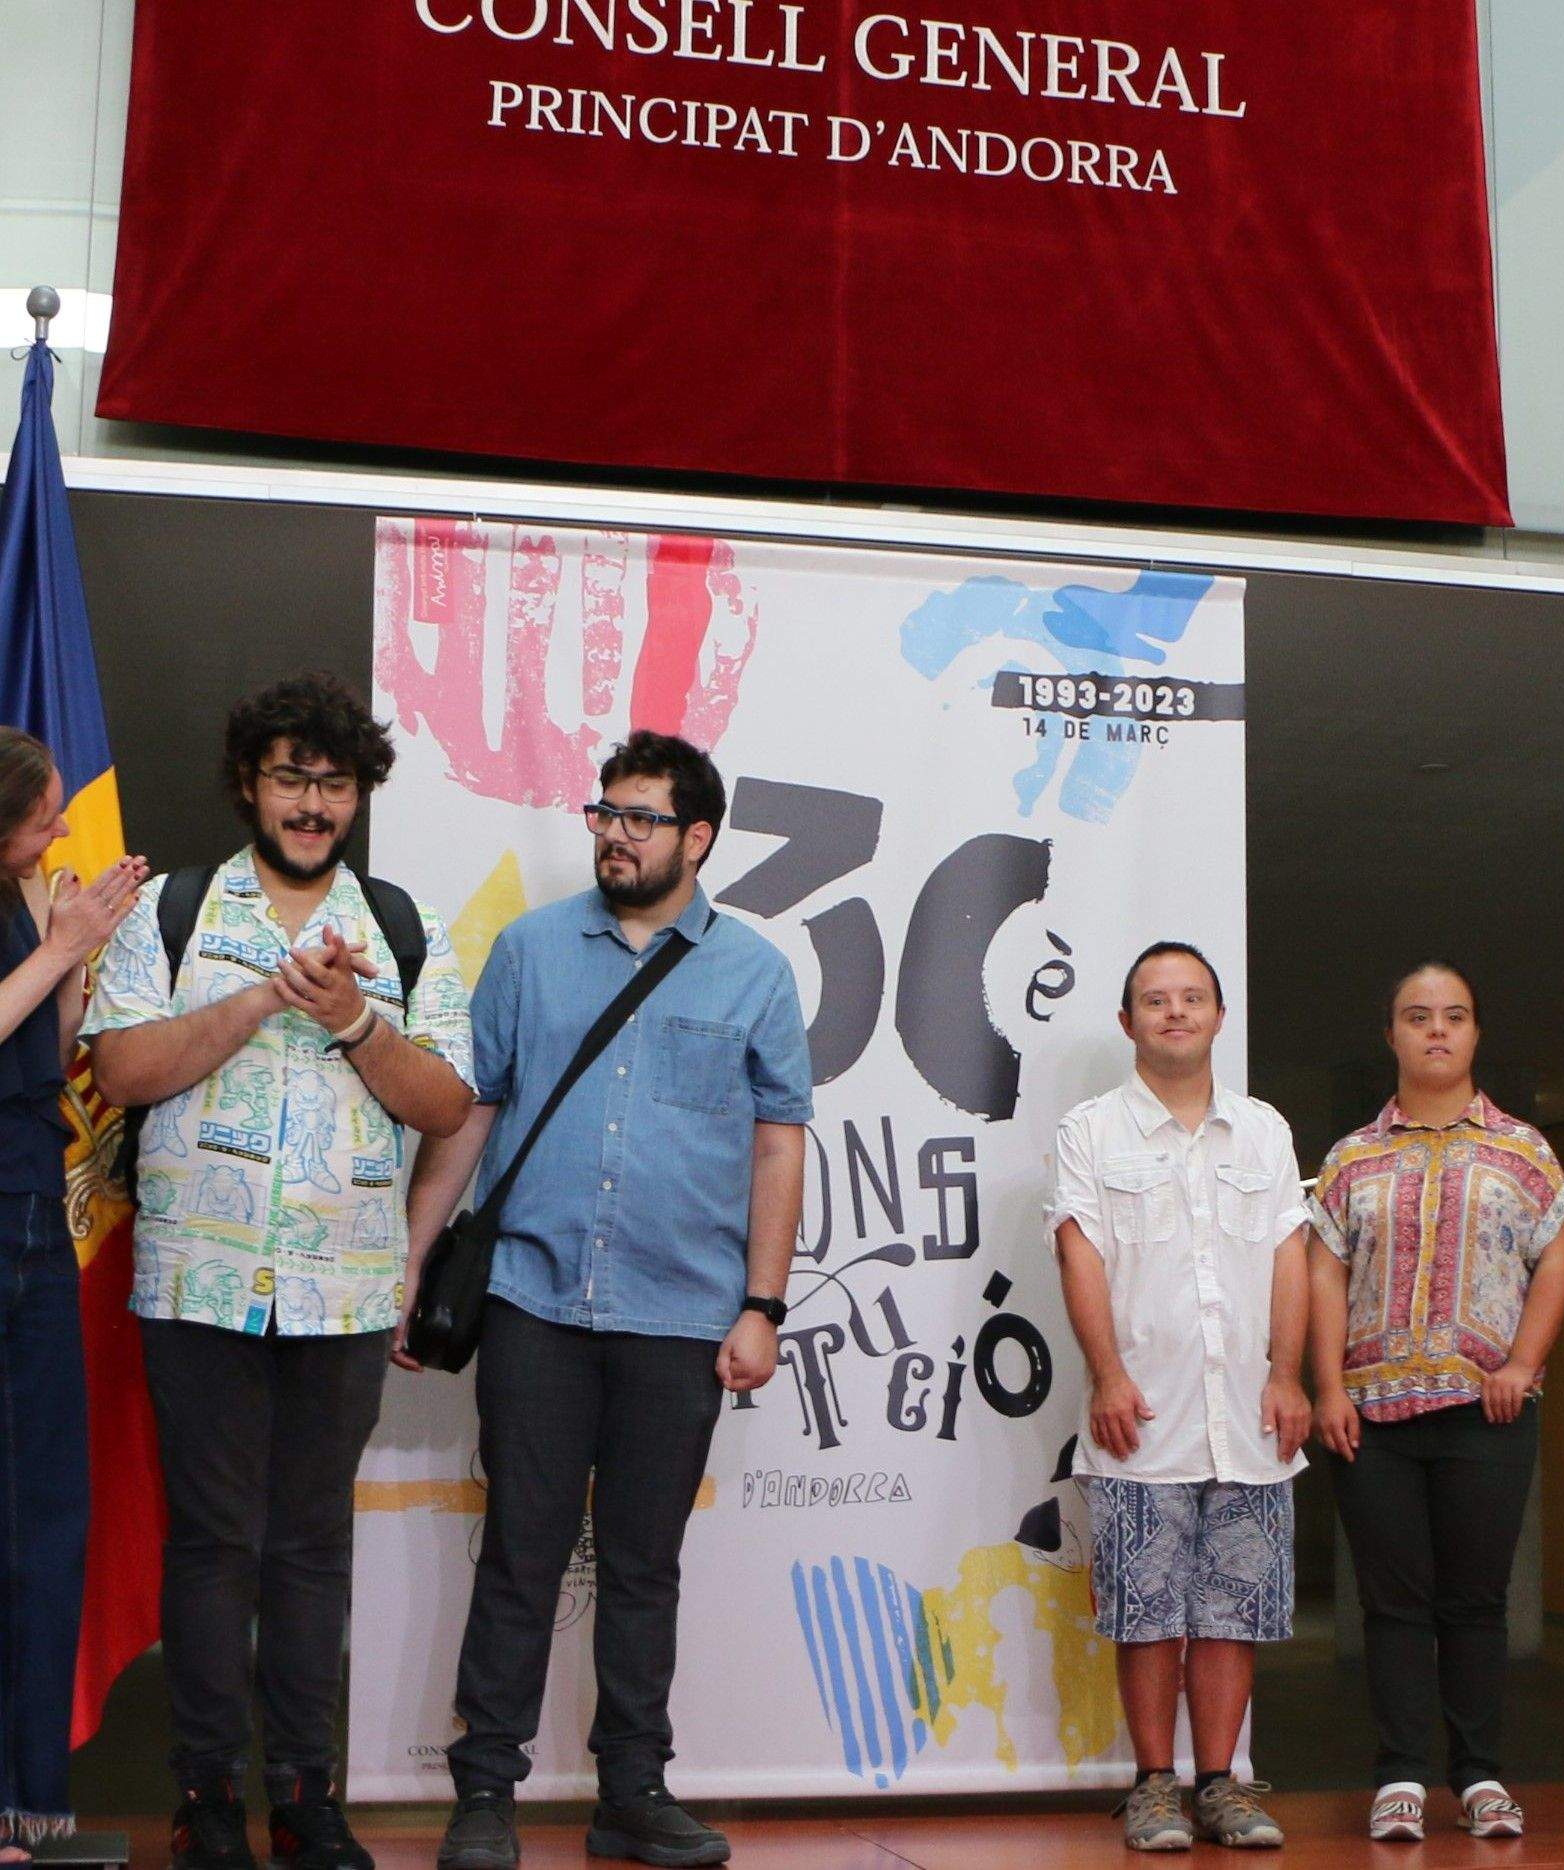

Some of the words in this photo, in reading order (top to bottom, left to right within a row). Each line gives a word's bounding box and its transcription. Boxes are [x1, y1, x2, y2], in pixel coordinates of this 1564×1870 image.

[853, 13, 1248, 119] GENERAL
[486, 79, 810, 157] PRINCIPAT
[826, 116, 1179, 195] D'ANDORRA
[1018, 675, 1196, 716] 1993-2023
[1023, 717, 1047, 738] 14
[1064, 720, 1090, 741] DE
[1107, 723, 1169, 749] MARÇ
[743, 1469, 912, 1508] D'ANDORRA
